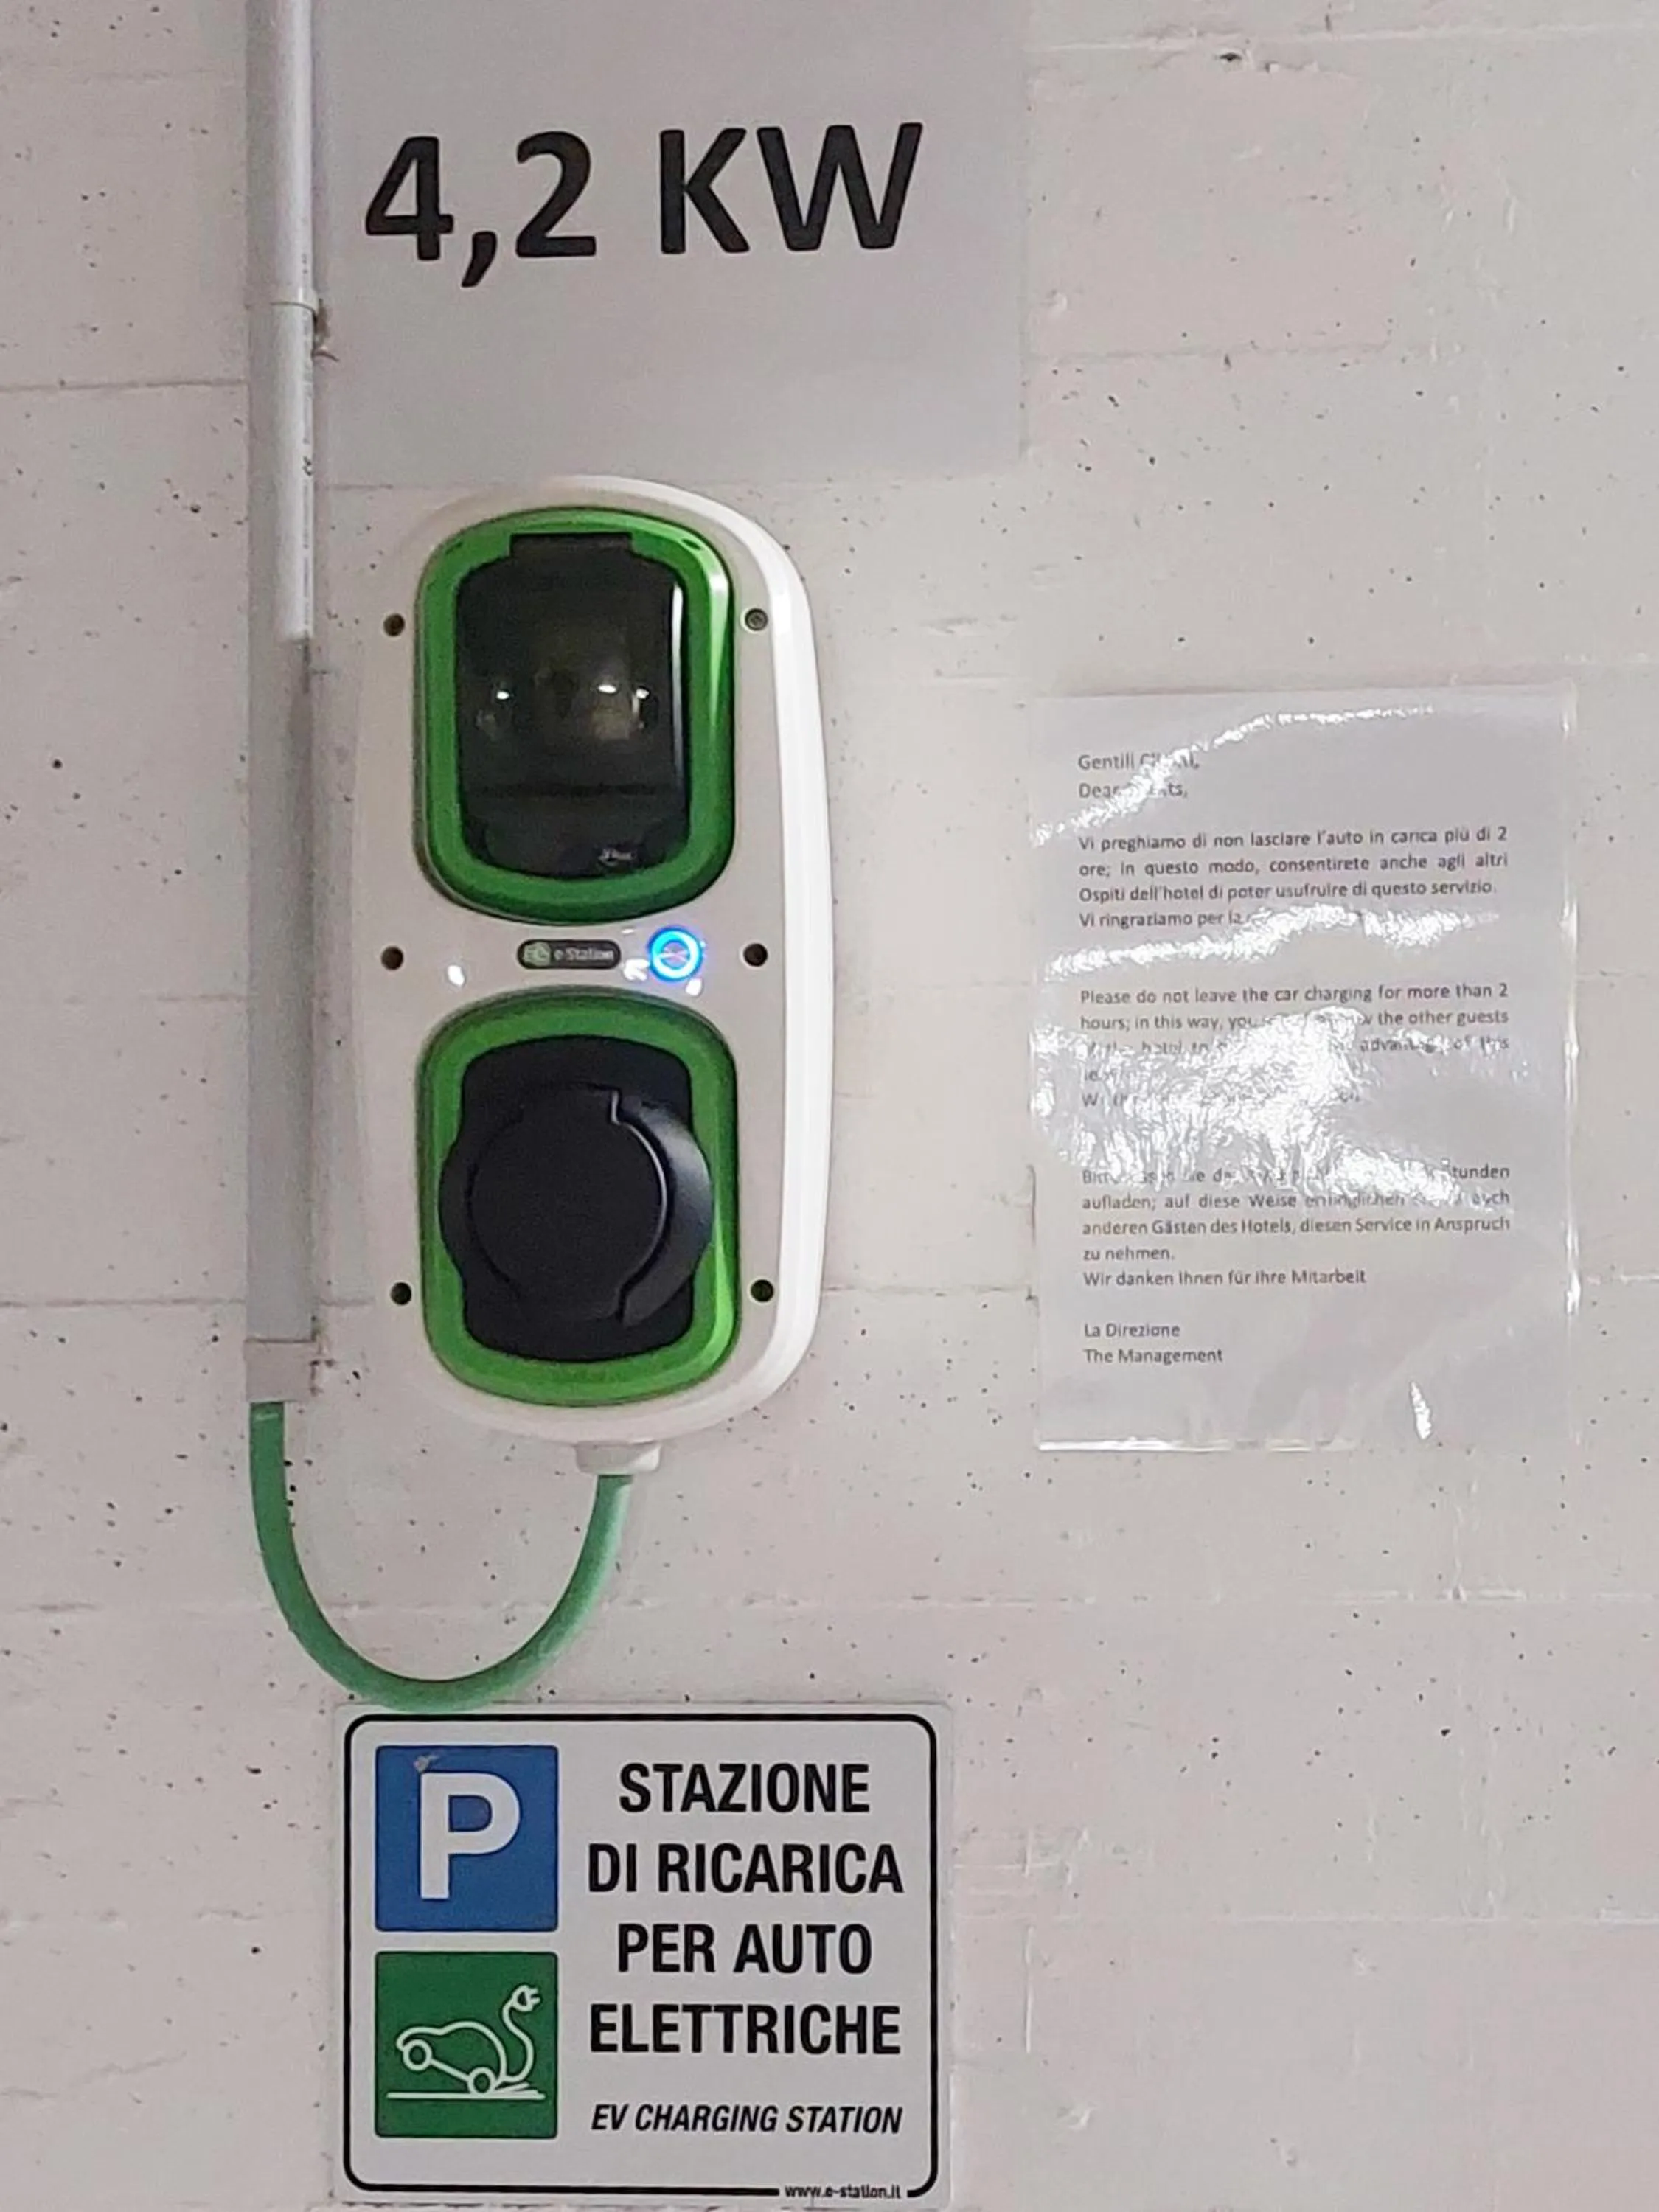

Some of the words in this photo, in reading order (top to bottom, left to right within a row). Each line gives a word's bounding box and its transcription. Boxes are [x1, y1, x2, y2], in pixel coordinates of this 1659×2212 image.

[365, 130, 597, 288] 4,2
[659, 122, 922, 254] KW
[1079, 837, 1094, 851] Vi
[1100, 835, 1186, 853] preghiamo
[1192, 833, 1208, 849] di
[1214, 835, 1244, 848] non
[1251, 831, 1310, 846] lasciare
[1370, 830, 1384, 844] in
[1391, 829, 1437, 844] carica
[1476, 827, 1492, 841] di
[1497, 826, 1508, 841] 2
[1079, 862, 1112, 879] ore;
[1121, 861, 1135, 875] in
[1144, 860, 1199, 878] questo
[1209, 859, 1261, 875] modo,
[1269, 857, 1370, 873] consentirete
[1380, 855, 1427, 870] anche
[1439, 854, 1466, 872] agli
[1475, 853, 1508, 867] altri
[1079, 886, 1125, 905] Ospiti
[1208, 885, 1223, 900] di
[1228, 884, 1271, 902] poter
[1276, 883, 1348, 898] usufruire
[1352, 881, 1368, 896] di
[1371, 880, 1427, 900] questo
[1079, 912, 1094, 927] Vi
[1099, 911, 1193, 930] ringraziamo
[1198, 911, 1223, 928] per
[1081, 989, 1131, 1004] Please
[1136, 989, 1157, 1004] do
[1162, 989, 1189, 1004] not
[1194, 987, 1237, 1003] leave
[1242, 987, 1268, 1002] the
[1274, 987, 1299, 1002] car
[1304, 986, 1372, 1004] charging
[1378, 984, 1402, 1000] for
[1407, 985, 1450, 999] more
[1455, 983, 1492, 998] than
[1498, 983, 1509, 998] 2
[1135, 1015, 1150, 1029] in
[1155, 1013, 1183, 1029] this
[1378, 1010, 1405, 1025] the
[1408, 1009, 1453, 1025] other
[1456, 1008, 1509, 1026] guests
[1164, 1194, 1189, 1209] auf
[1199, 1192, 1240, 1208] diese
[1248, 1192, 1297, 1208] Weise
[1082, 1219, 1147, 1235] anderen
[1210, 1218, 1237, 1234] des
[1300, 1217, 1352, 1233] diesen
[1356, 1215, 1412, 1232] Service
[1416, 1215, 1430, 1231] in
[1434, 1214, 1510, 1234] Anspruch
[1083, 1248, 1101, 1261] zu
[1084, 1271, 1112, 1286] Wir
[1116, 1270, 1174, 1286] danken
[1178, 1270, 1224, 1286] Ihnen
[1291, 1268, 1366, 1284] Mitarbeit
[1084, 1324, 1101, 1337] La
[1105, 1323, 1180, 1337] Direzione
[1084, 1349, 1113, 1363] The
[1118, 1348, 1223, 1366] Management
[618, 1763, 871, 1813] STAZIONE
[420, 1771, 521, 1900] P
[589, 1844, 636, 1893] DI
[658, 1844, 904, 1893] RICARICA
[617, 1924, 716, 1973] PER
[734, 1924, 872, 1973] AUTO
[590, 2004, 902, 2054] ELETTRICHE
[591, 2104, 628, 2131] EV
[634, 2104, 778, 2132] CHARGING
[785, 2105, 902, 2134] STATION
[785, 2184, 900, 2198] www.e-station.it
